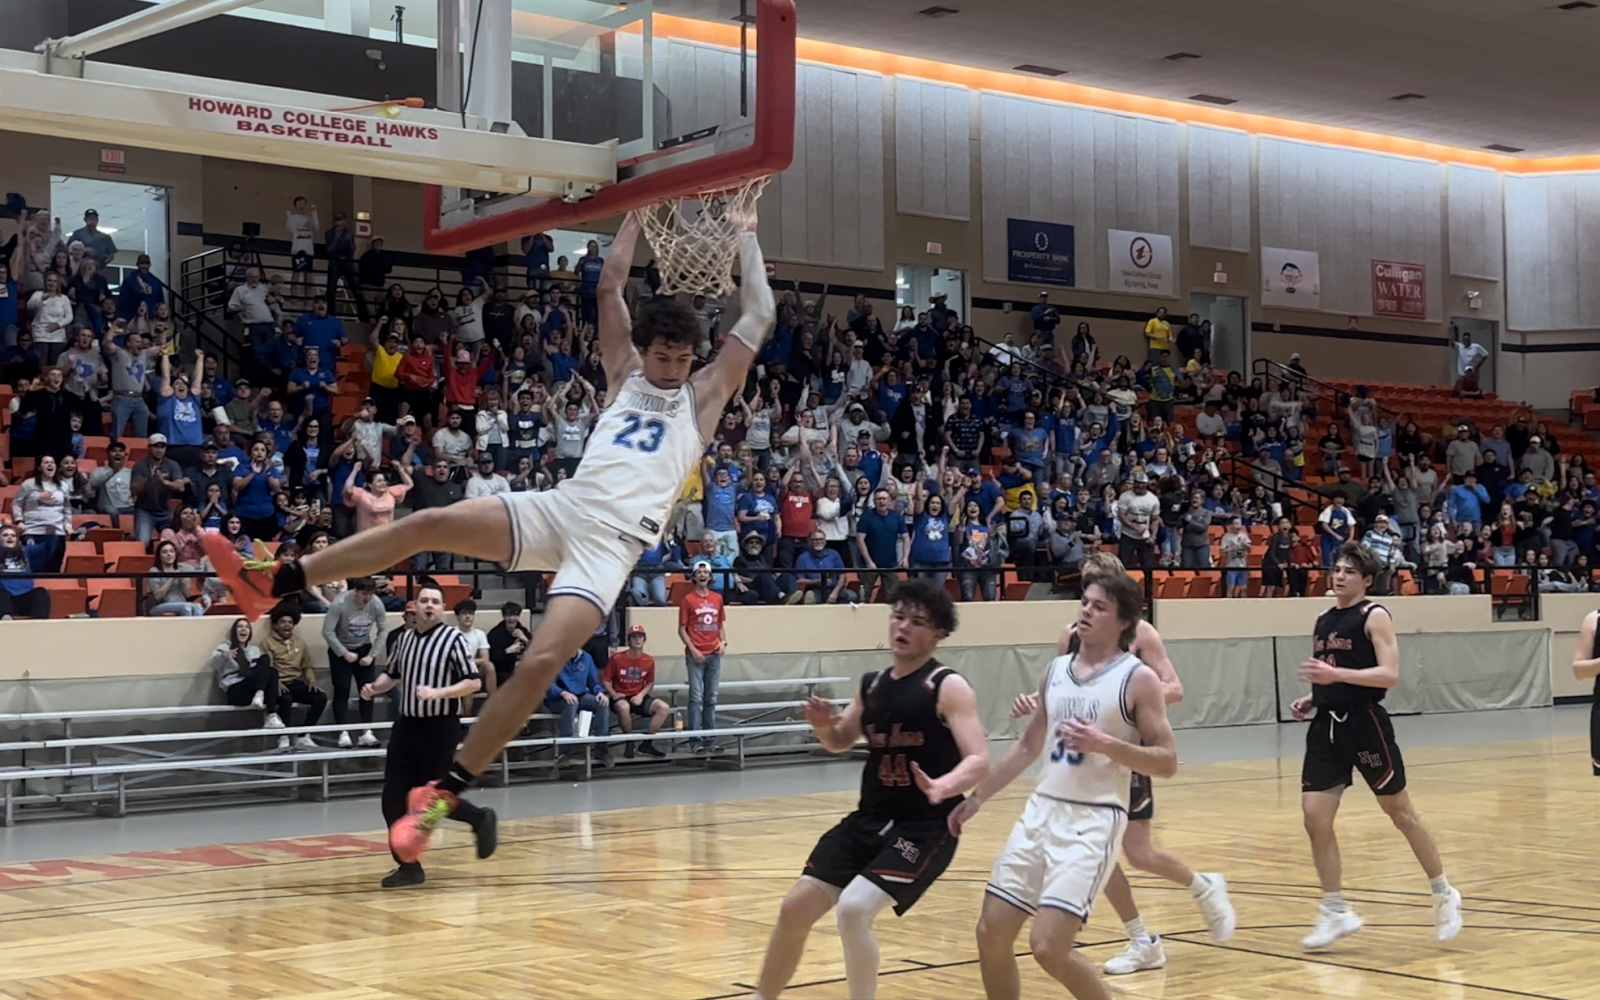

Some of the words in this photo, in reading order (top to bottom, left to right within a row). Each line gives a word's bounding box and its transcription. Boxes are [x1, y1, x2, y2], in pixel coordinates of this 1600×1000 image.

[188, 97, 273, 120] HOWARD
[283, 110, 367, 133] COLLEGE
[376, 122, 439, 140] HAWKS
[236, 120, 392, 148] BASKETBALL
[1012, 249, 1050, 261] PROSPERITY
[1051, 253, 1069, 262] BANK
[1376, 264, 1422, 282] Culligan
[1377, 281, 1421, 299] WATER
[612, 413, 665, 454] 23
[878, 753, 911, 786] 44
